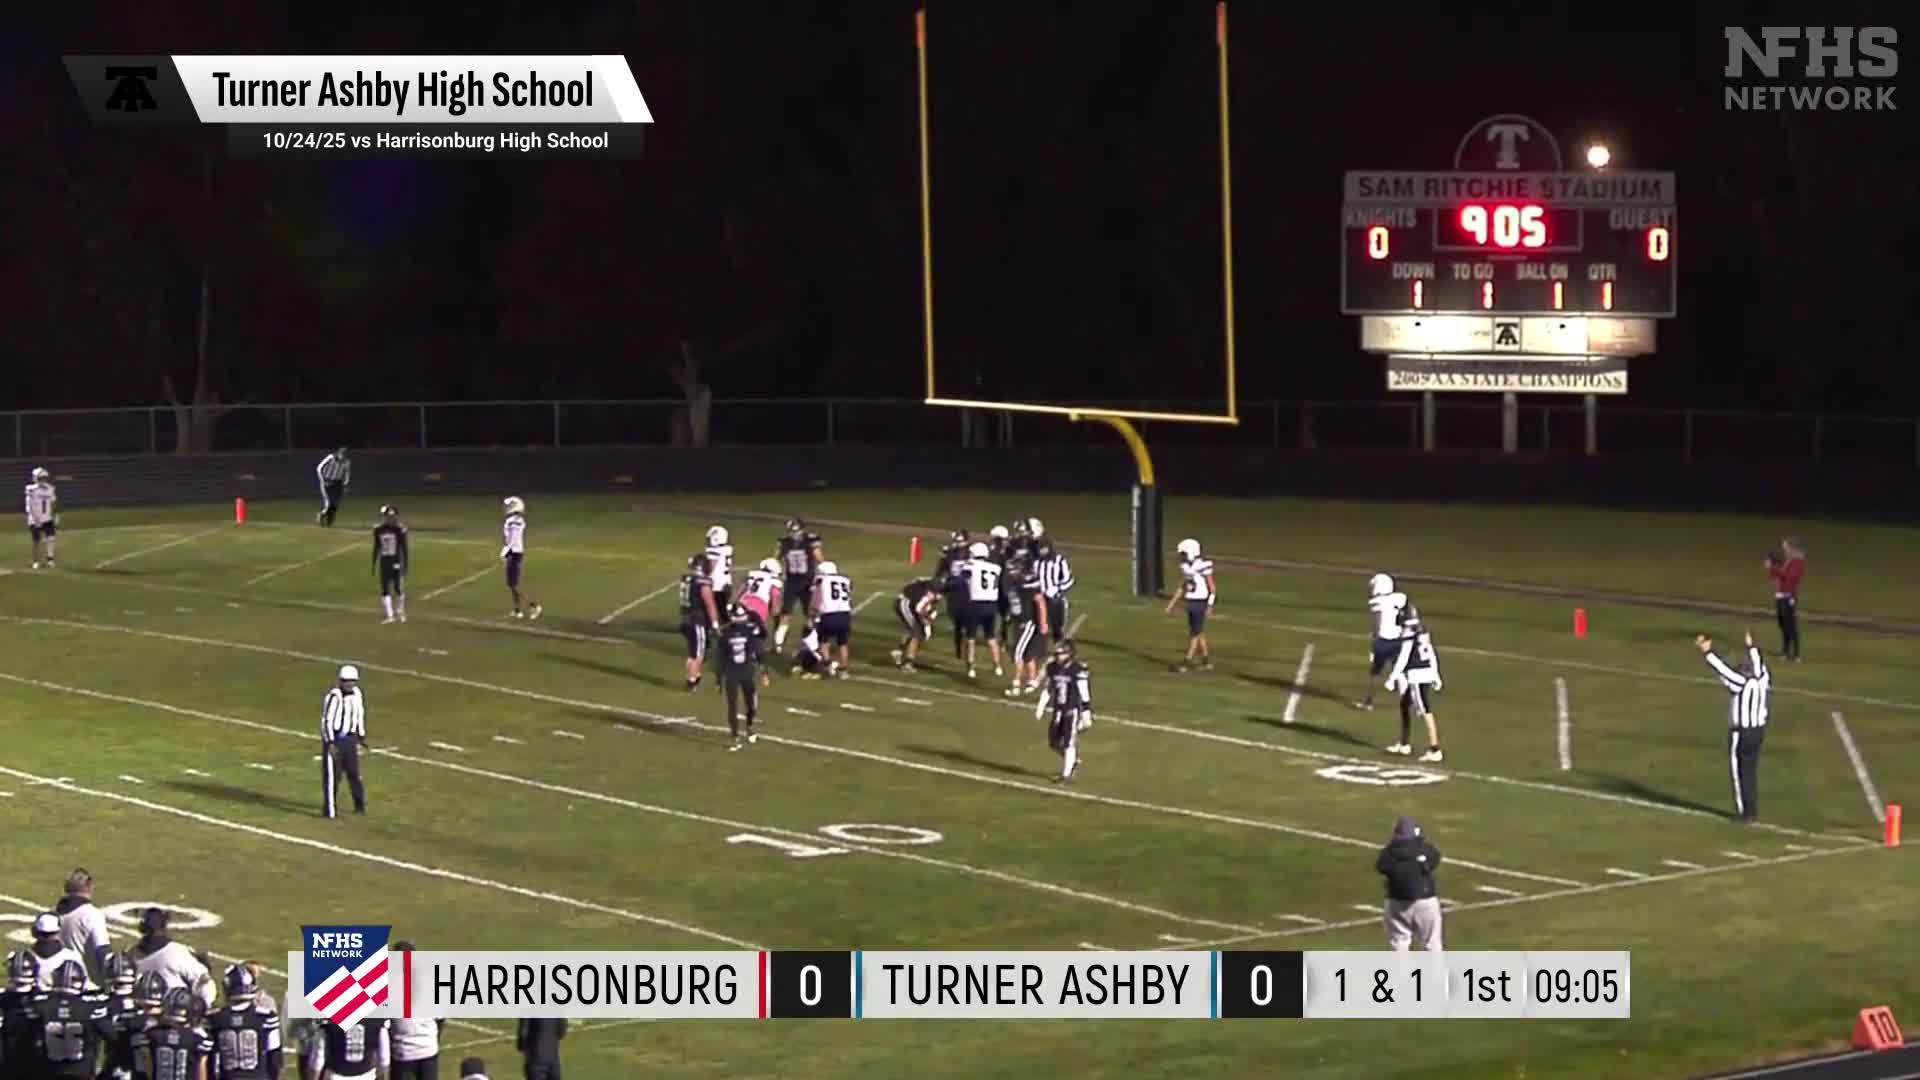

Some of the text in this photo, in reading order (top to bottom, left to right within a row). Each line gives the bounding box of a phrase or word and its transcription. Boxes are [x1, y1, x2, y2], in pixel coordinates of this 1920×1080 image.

[1359, 175, 1662, 200] SAM RITCHIE STADIUM
[1609, 208, 1672, 230] GUEST
[1369, 226, 1389, 260] 0
[1647, 227, 1669, 261] 0
[1392, 263, 1434, 279] DOWN
[1453, 263, 1494, 280] TO GO
[1516, 263, 1568, 280] BALL ON
[1587, 263, 1616, 280] QTR
[1554, 281, 1563, 310] 1
[1603, 281, 1612, 310] 1
[1459, 373, 1515, 388] STATE
[1518, 374, 1623, 390] CHAMPIONS
[1868, 1011, 1899, 1044] 10
